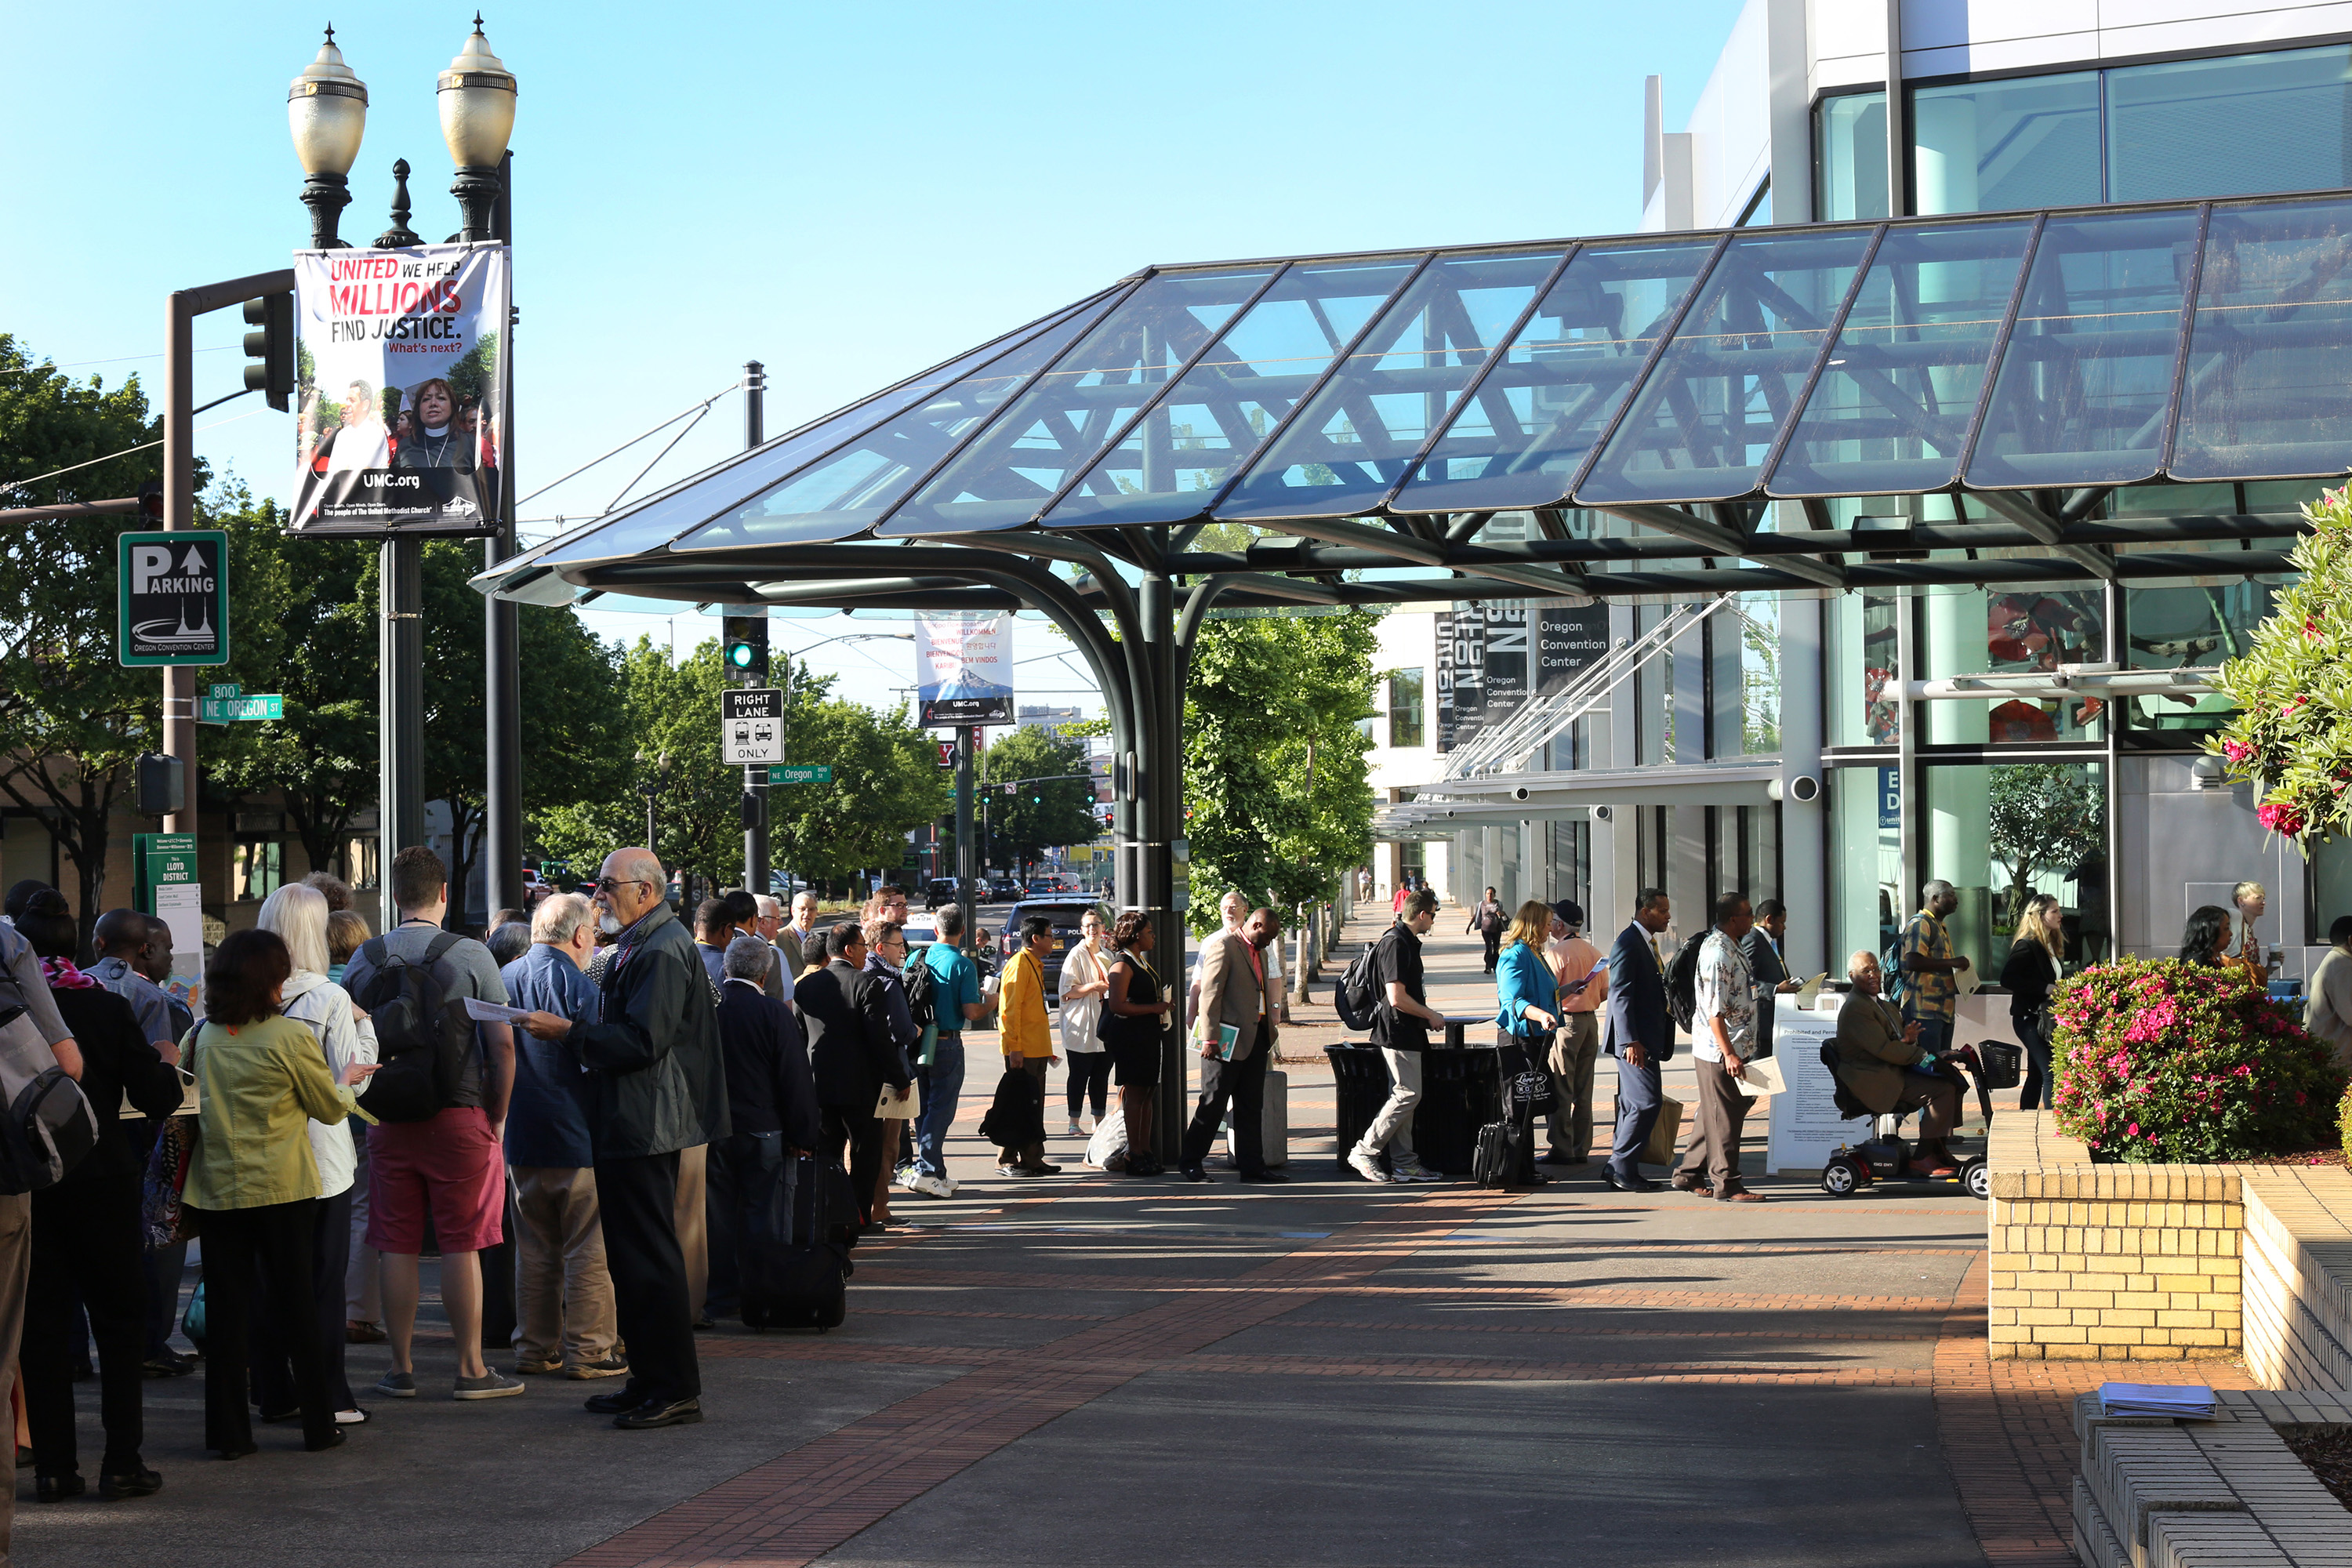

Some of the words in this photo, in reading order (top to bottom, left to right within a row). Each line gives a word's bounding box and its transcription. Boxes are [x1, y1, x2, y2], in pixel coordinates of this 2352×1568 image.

[332, 258, 398, 281] UNITED
[403, 263, 422, 278] WE
[426, 261, 461, 277] HELP
[329, 279, 462, 315] MILLIONS
[332, 320, 365, 343] FIND
[371, 317, 461, 339] JUSTICE.
[389, 343, 427, 353] What's
[430, 342, 462, 353] next?
[364, 475, 420, 490] UMC.org
[133, 546, 214, 594] PARKING
[1540, 621, 1582, 633] Oregon
[1541, 639, 1606, 650] Convention
[1541, 656, 1581, 667] Center
[1487, 676, 1515, 685] Oregon
[214, 686, 235, 698] 800
[734, 694, 770, 705] RIGHT
[206, 701, 220, 717] NE
[227, 700, 267, 716] OREGON
[270, 703, 279, 712] ST
[736, 706, 769, 717] LANE
[738, 748, 768, 759] ONLY
[785, 769, 812, 781] Oregon
[167, 862, 184, 871] LLOYD
[163, 872, 188, 881] DISTRICT
